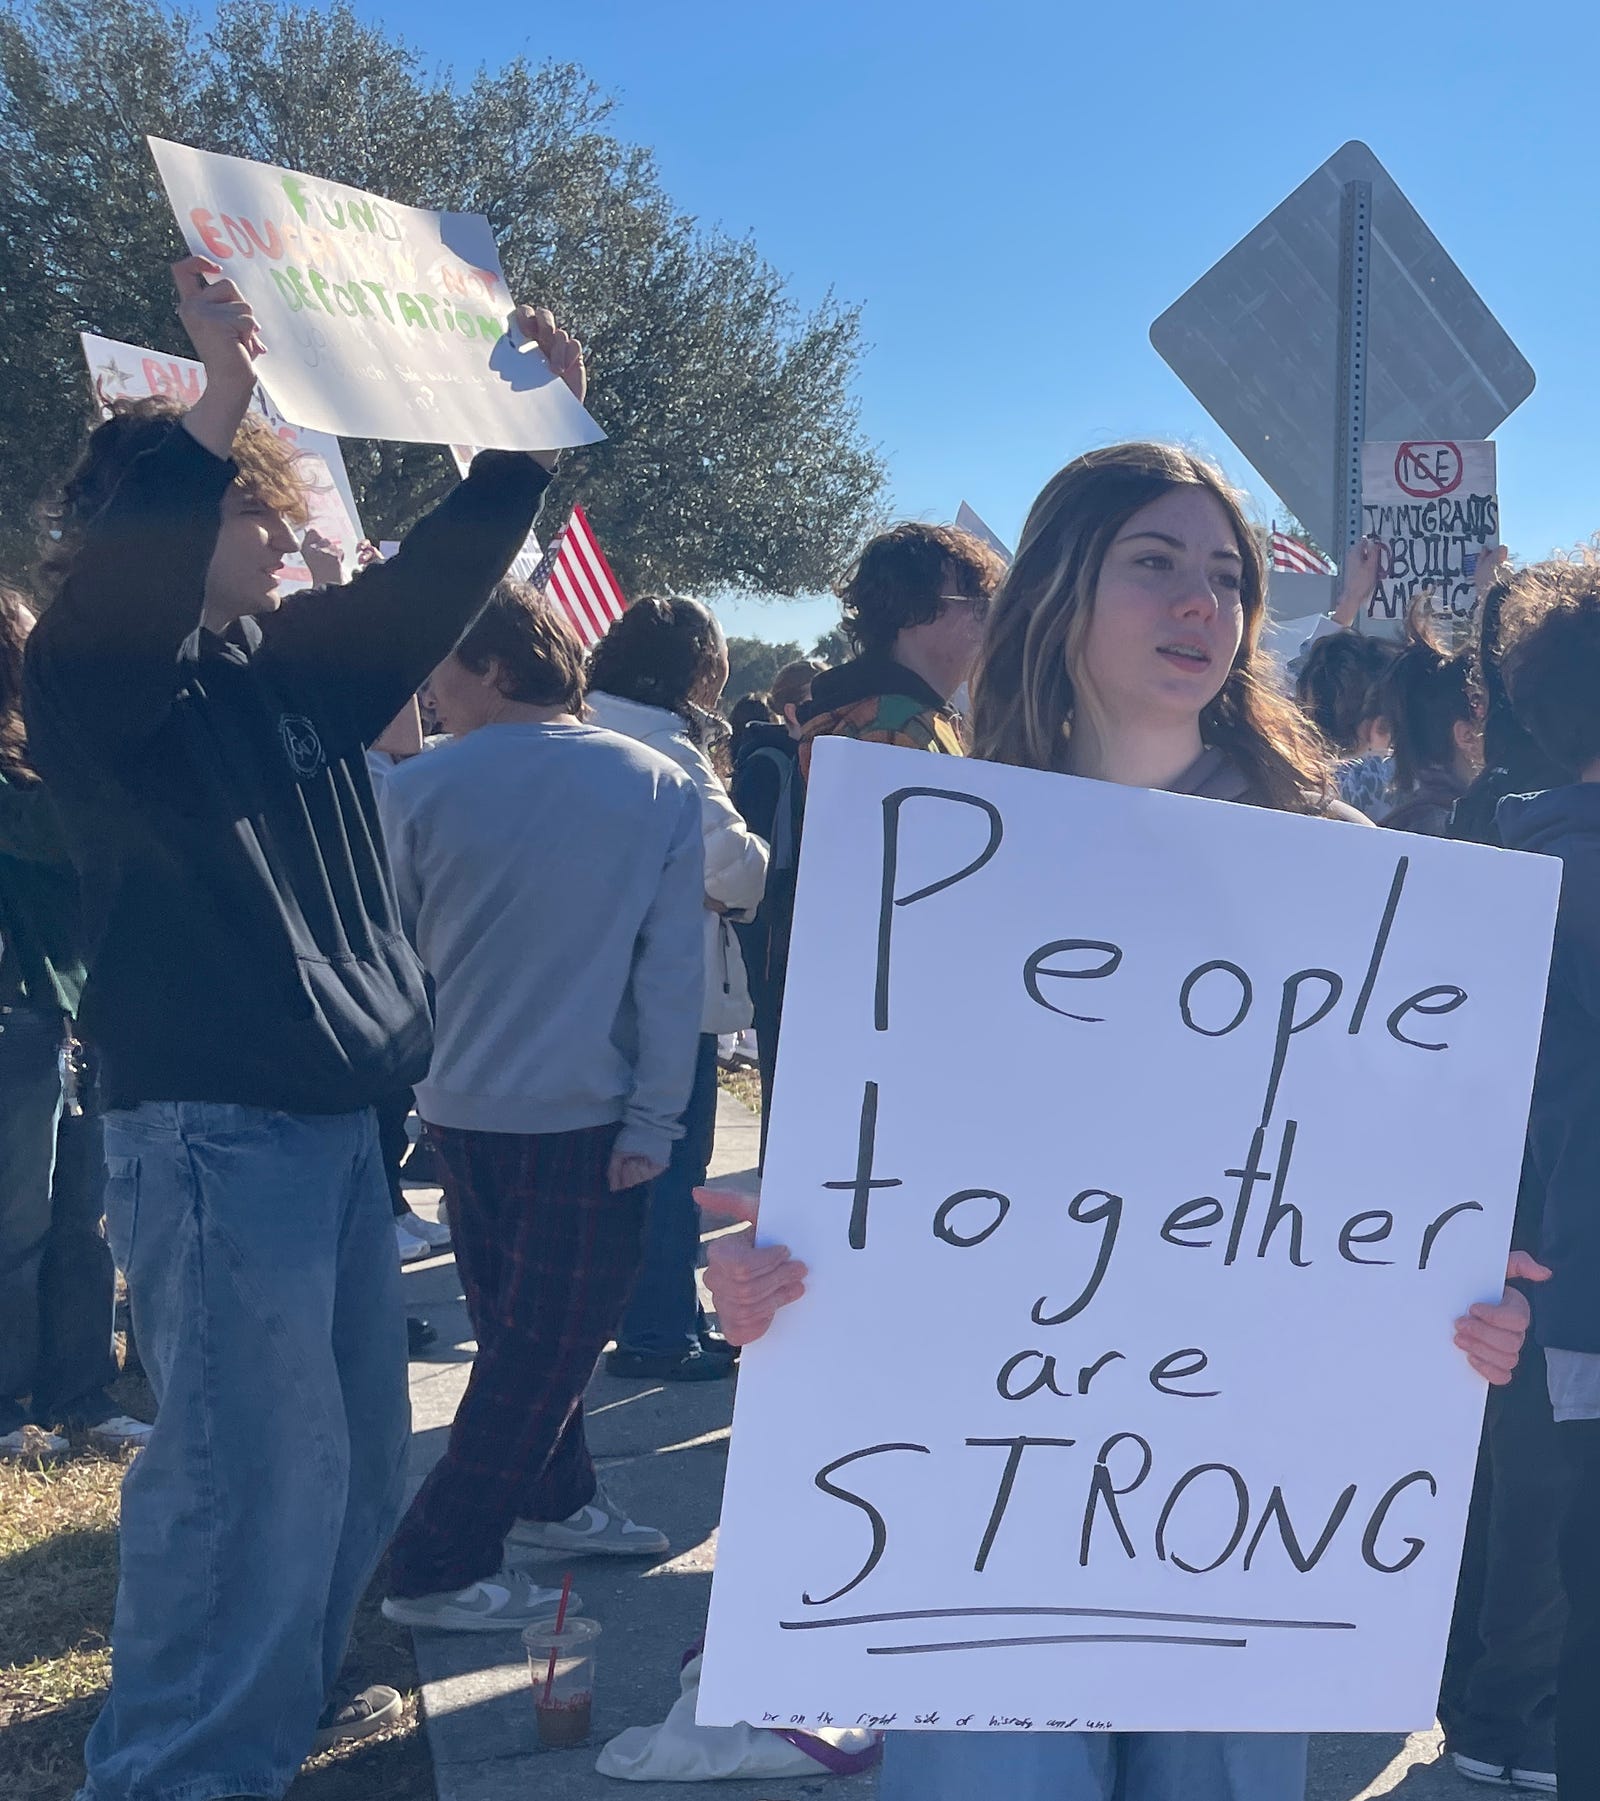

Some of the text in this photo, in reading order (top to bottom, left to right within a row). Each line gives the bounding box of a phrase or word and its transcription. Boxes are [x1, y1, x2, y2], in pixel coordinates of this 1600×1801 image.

[281, 174, 402, 242] FUND
[440, 264, 500, 303] NOT
[1402, 449, 1450, 483] ICE
[1363, 493, 1498, 544] IMMIGRANTS
[1388, 533, 1473, 579] BUILT
[874, 786, 1469, 1128] People
[821, 1080, 1484, 1326] together
[996, 1347, 1222, 1401] are
[802, 1432, 1438, 1605] STRONG
[790, 1714, 806, 1724] on
[816, 1711, 834, 1725] the
[856, 1712, 897, 1728] right
[914, 1711, 941, 1725] side
[955, 1714, 975, 1727] of
[1046, 1718, 1078, 1729] and
